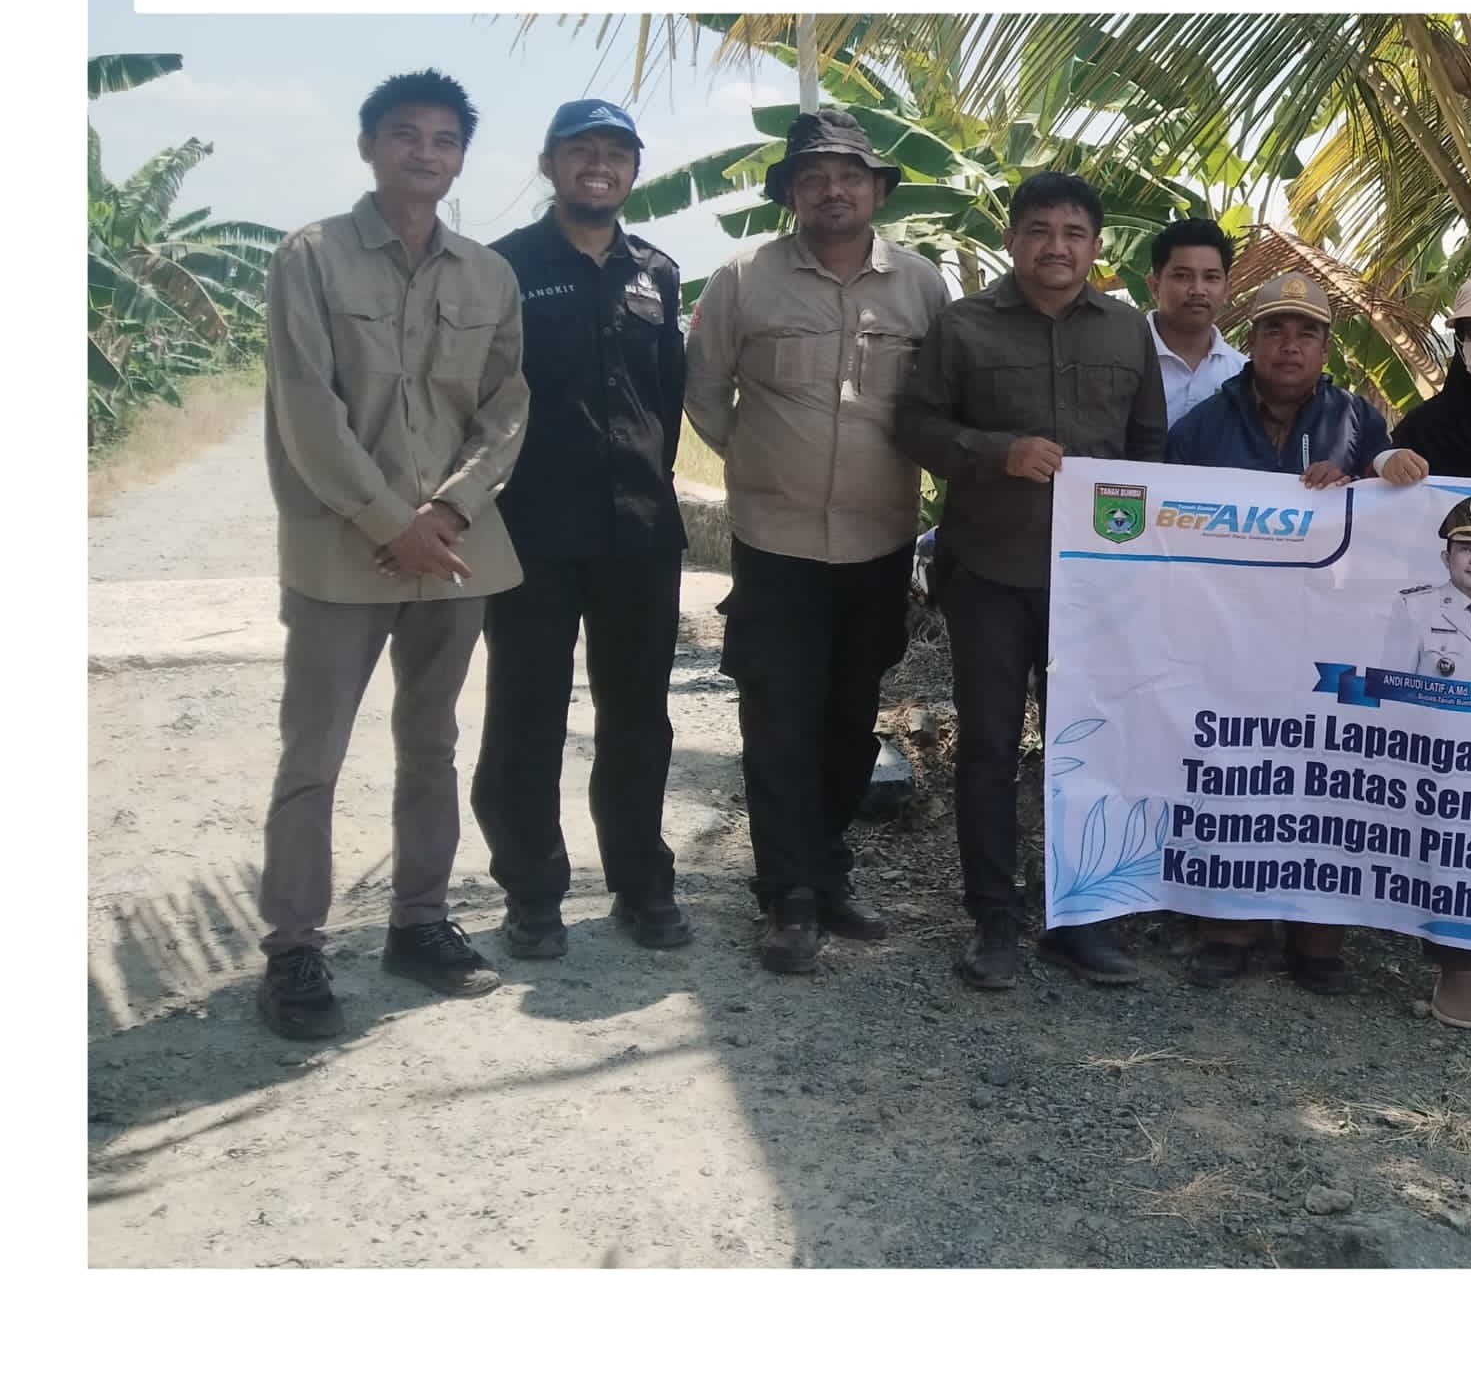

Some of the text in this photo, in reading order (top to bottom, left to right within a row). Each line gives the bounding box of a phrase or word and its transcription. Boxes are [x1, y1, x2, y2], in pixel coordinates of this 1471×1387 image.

[1194, 710, 1316, 749] Survei
[1183, 759, 1294, 796] Tanda
[1305, 761, 1407, 809] Batas
[1173, 804, 1410, 853] Pemasangan
[1163, 848, 1361, 896] Kabupaten
